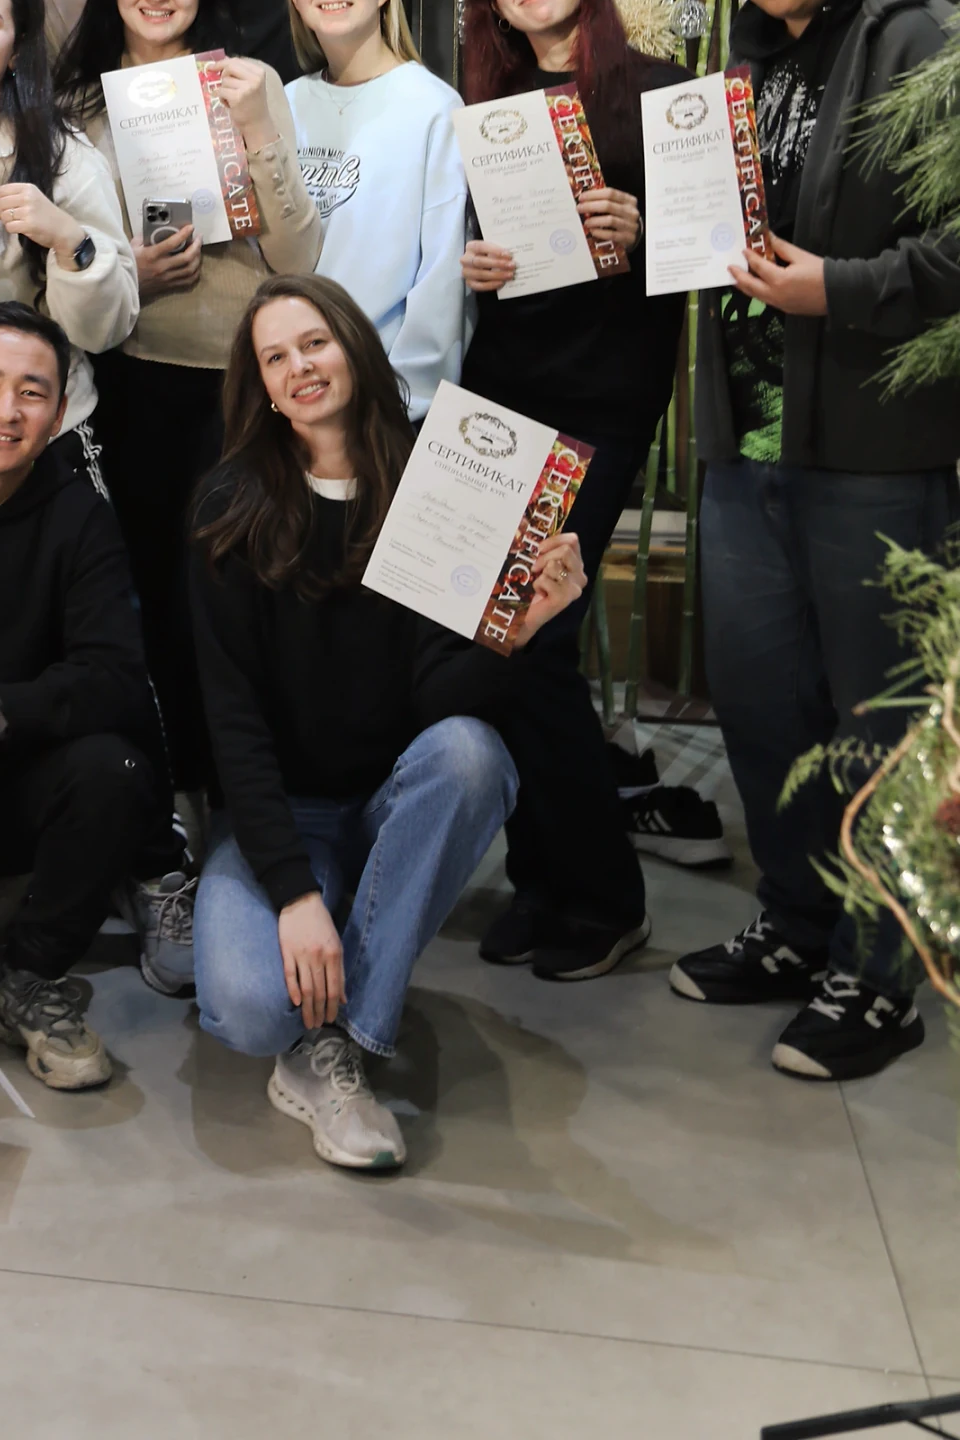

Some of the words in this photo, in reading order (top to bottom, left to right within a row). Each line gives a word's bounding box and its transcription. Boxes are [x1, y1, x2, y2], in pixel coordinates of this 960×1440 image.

[119, 104, 199, 130] СЕРТИФИКАТ
[302, 147, 326, 157] UNION
[471, 141, 553, 168] СЕРТИФИКАТ
[652, 128, 726, 155] СЕРТИФИКАТ
[729, 77, 766, 260] CERTIFICAT
[427, 440, 527, 494] СЕРТИФИКАТ
[484, 448, 579, 644] CERTIFICATE
